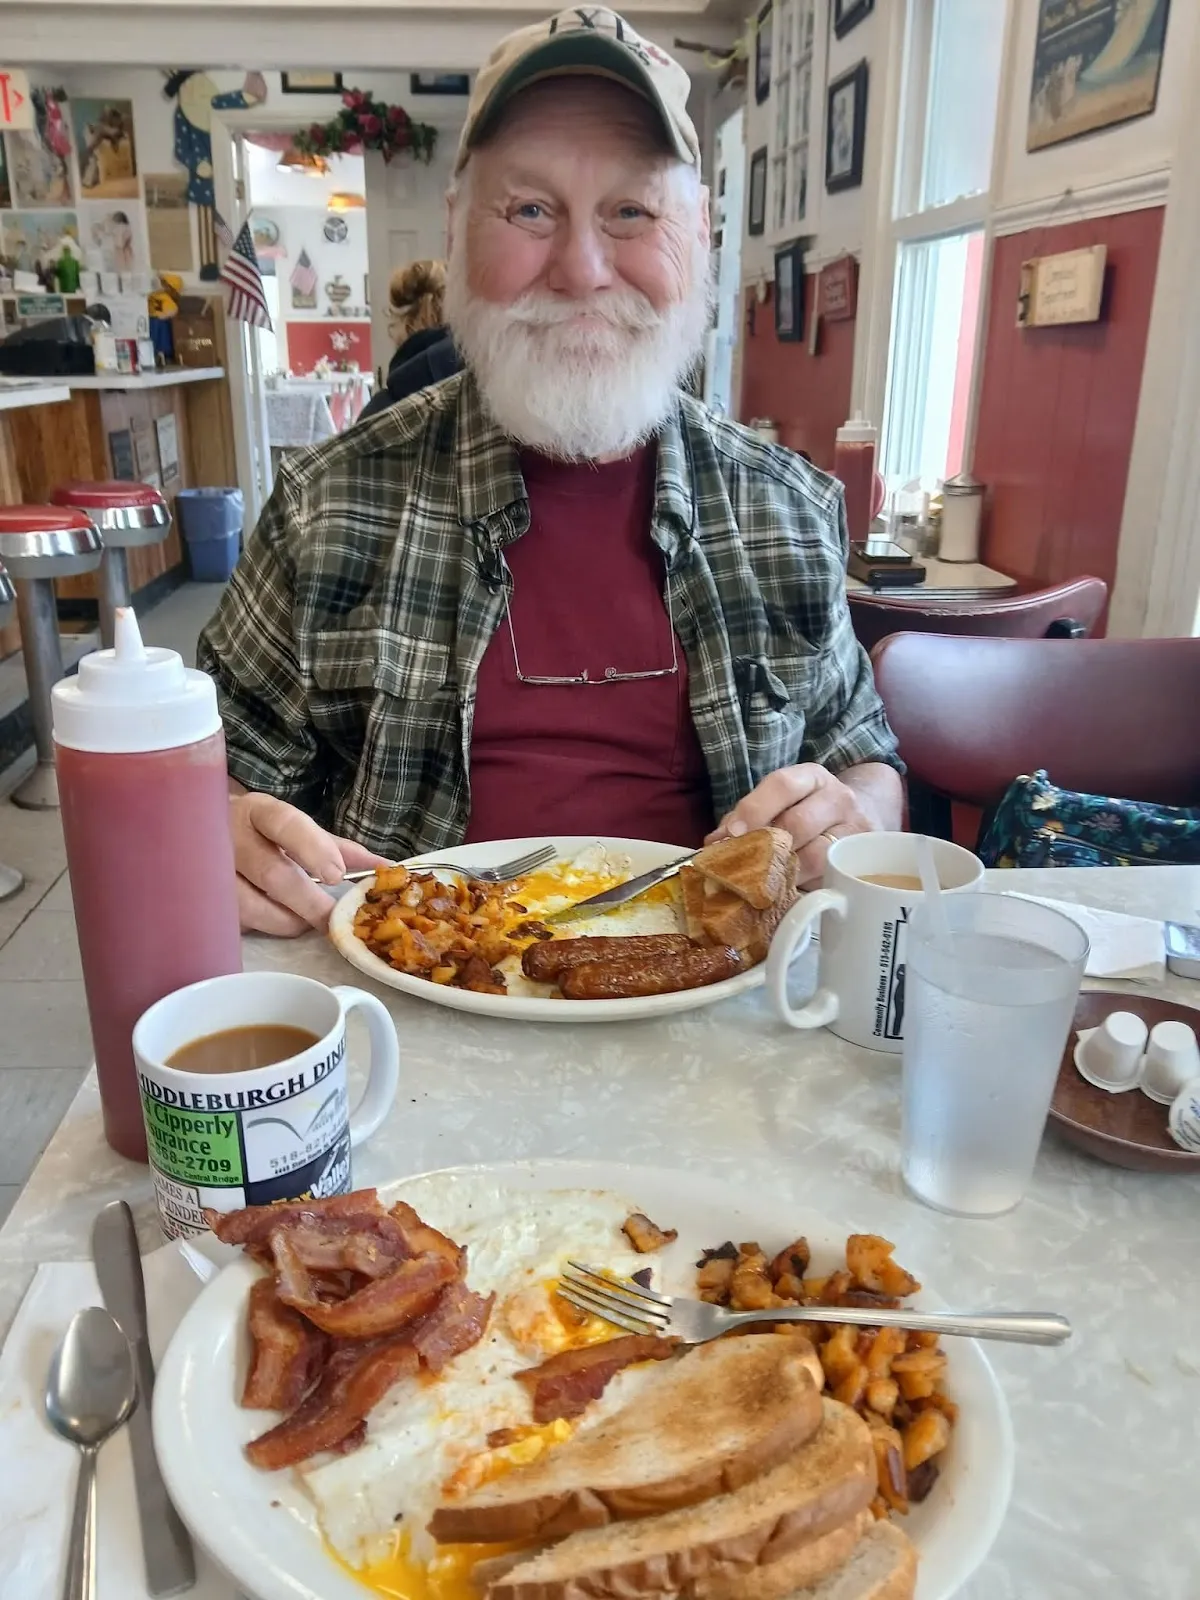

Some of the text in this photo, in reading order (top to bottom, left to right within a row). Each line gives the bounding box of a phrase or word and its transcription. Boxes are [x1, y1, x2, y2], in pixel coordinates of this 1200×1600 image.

[154, 1103, 234, 1138] Cipperly
[147, 1122, 211, 1155] surance
[156, 1177, 183, 1201] AMES
[184, 1171, 210, 1182] Central
[212, 1174, 239, 1184] Bridge
